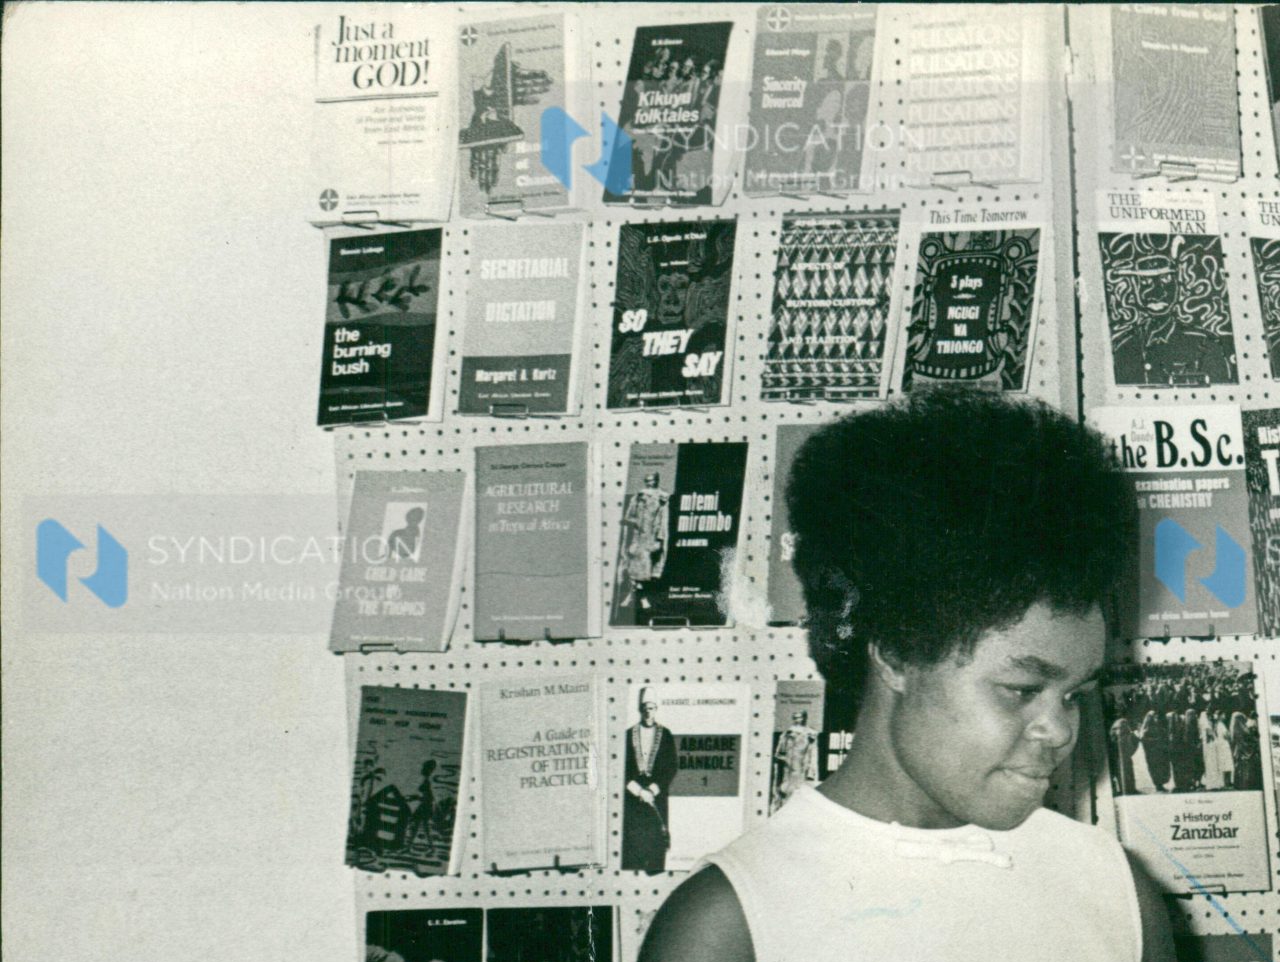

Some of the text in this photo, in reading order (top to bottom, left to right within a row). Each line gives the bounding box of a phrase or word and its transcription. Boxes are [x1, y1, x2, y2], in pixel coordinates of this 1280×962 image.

[332, 16, 375, 45] Just
[335, 38, 430, 63] moment
[353, 60, 430, 89] GOD!
[763, 76, 807, 92] Sincerity
[637, 91, 692, 108] Kikuyu
[634, 109, 700, 125] folktales
[1108, 193, 1142, 206] THE
[929, 208, 1028, 224] This Time Tomorrow
[1109, 207, 1206, 222] UNIFORMED
[1169, 221, 1207, 234] MAN
[480, 257, 570, 280] SECRETARIAL
[485, 301, 557, 322] DICTATION
[947, 305, 980, 320] NGUGI
[618, 309, 648, 334] SO
[334, 327, 360, 343] the
[953, 324, 968, 337] WA
[333, 341, 392, 359] burning
[642, 328, 694, 356] THEY
[936, 340, 984, 354] THIONGO
[332, 358, 369, 376] bush
[681, 351, 723, 378] SAY
[475, 368, 517, 384] Margaret
[1153, 418, 1244, 468] B.Sc.
[485, 482, 573, 497] AGRICULTURAL
[1196, 478, 1231, 492] papers
[497, 499, 560, 514] RESEARCH
[1149, 493, 1213, 509] CHEMISTRY
[677, 511, 733, 532] mirambo
[500, 686, 541, 699] Krishan
[532, 728, 591, 742] A Guide to
[487, 741, 591, 762] REGISTRATION
[531, 756, 589, 773] OF TITLE
[520, 775, 590, 789] PRACTICE
[1183, 812, 1220, 825] History
[1222, 810, 1232, 821] of
[1170, 824, 1239, 841] Zanzibar
